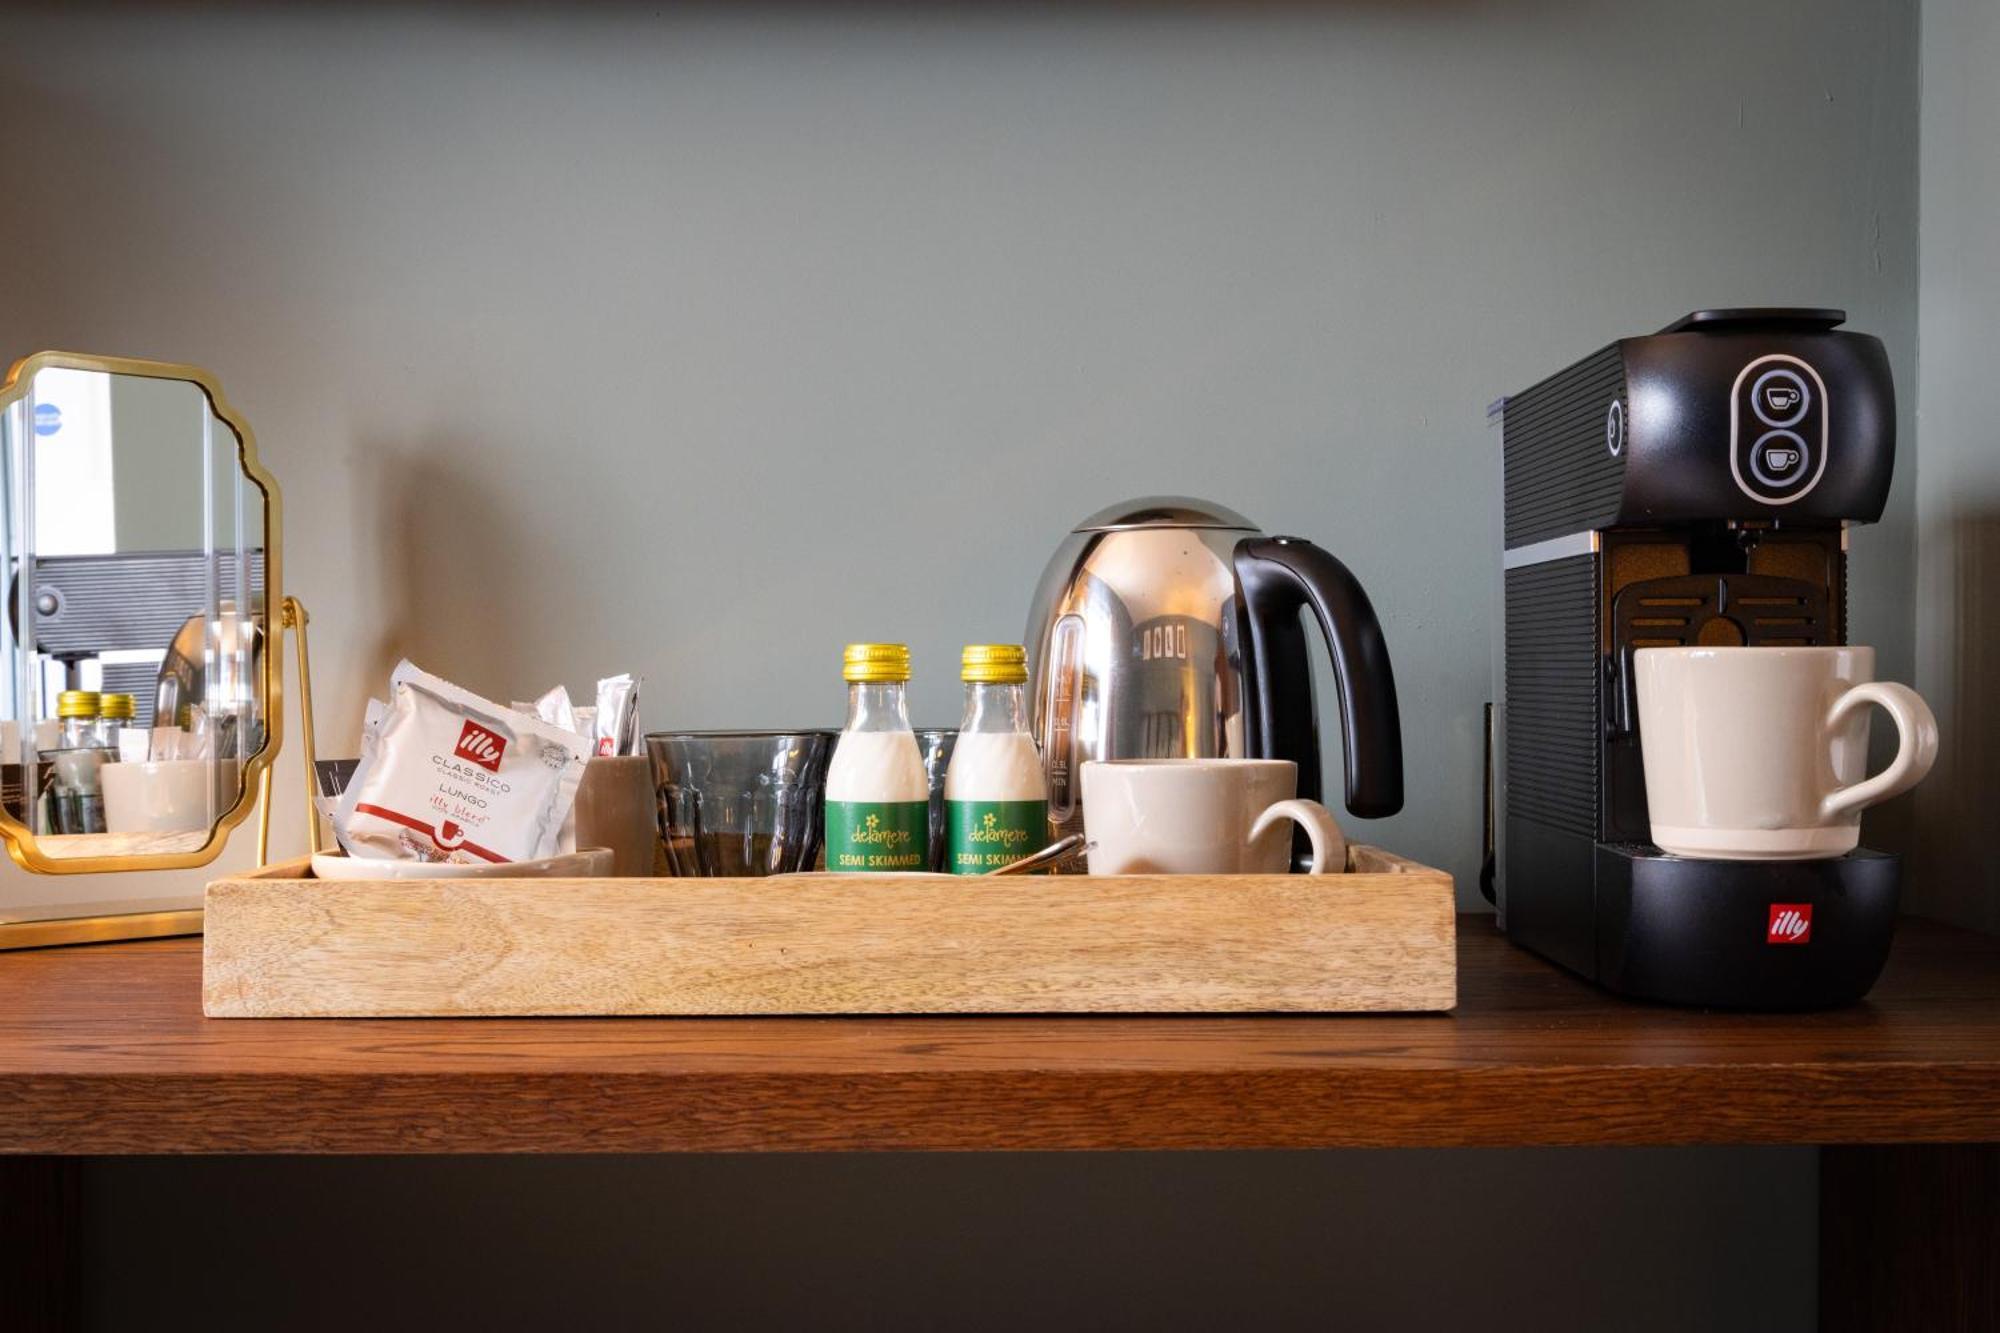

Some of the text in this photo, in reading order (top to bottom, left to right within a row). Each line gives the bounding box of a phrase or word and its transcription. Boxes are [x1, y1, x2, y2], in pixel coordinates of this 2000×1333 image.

[460, 729, 500, 762] illy
[432, 755, 511, 793] CLASSICO
[439, 783, 488, 809] LUNGO
[851, 824, 912, 849] delamere
[968, 823, 1029, 848] delamere
[839, 854, 921, 866] SEMI SKIMMED
[957, 853, 982, 865] SEMI
[1771, 910, 1809, 941] illy
